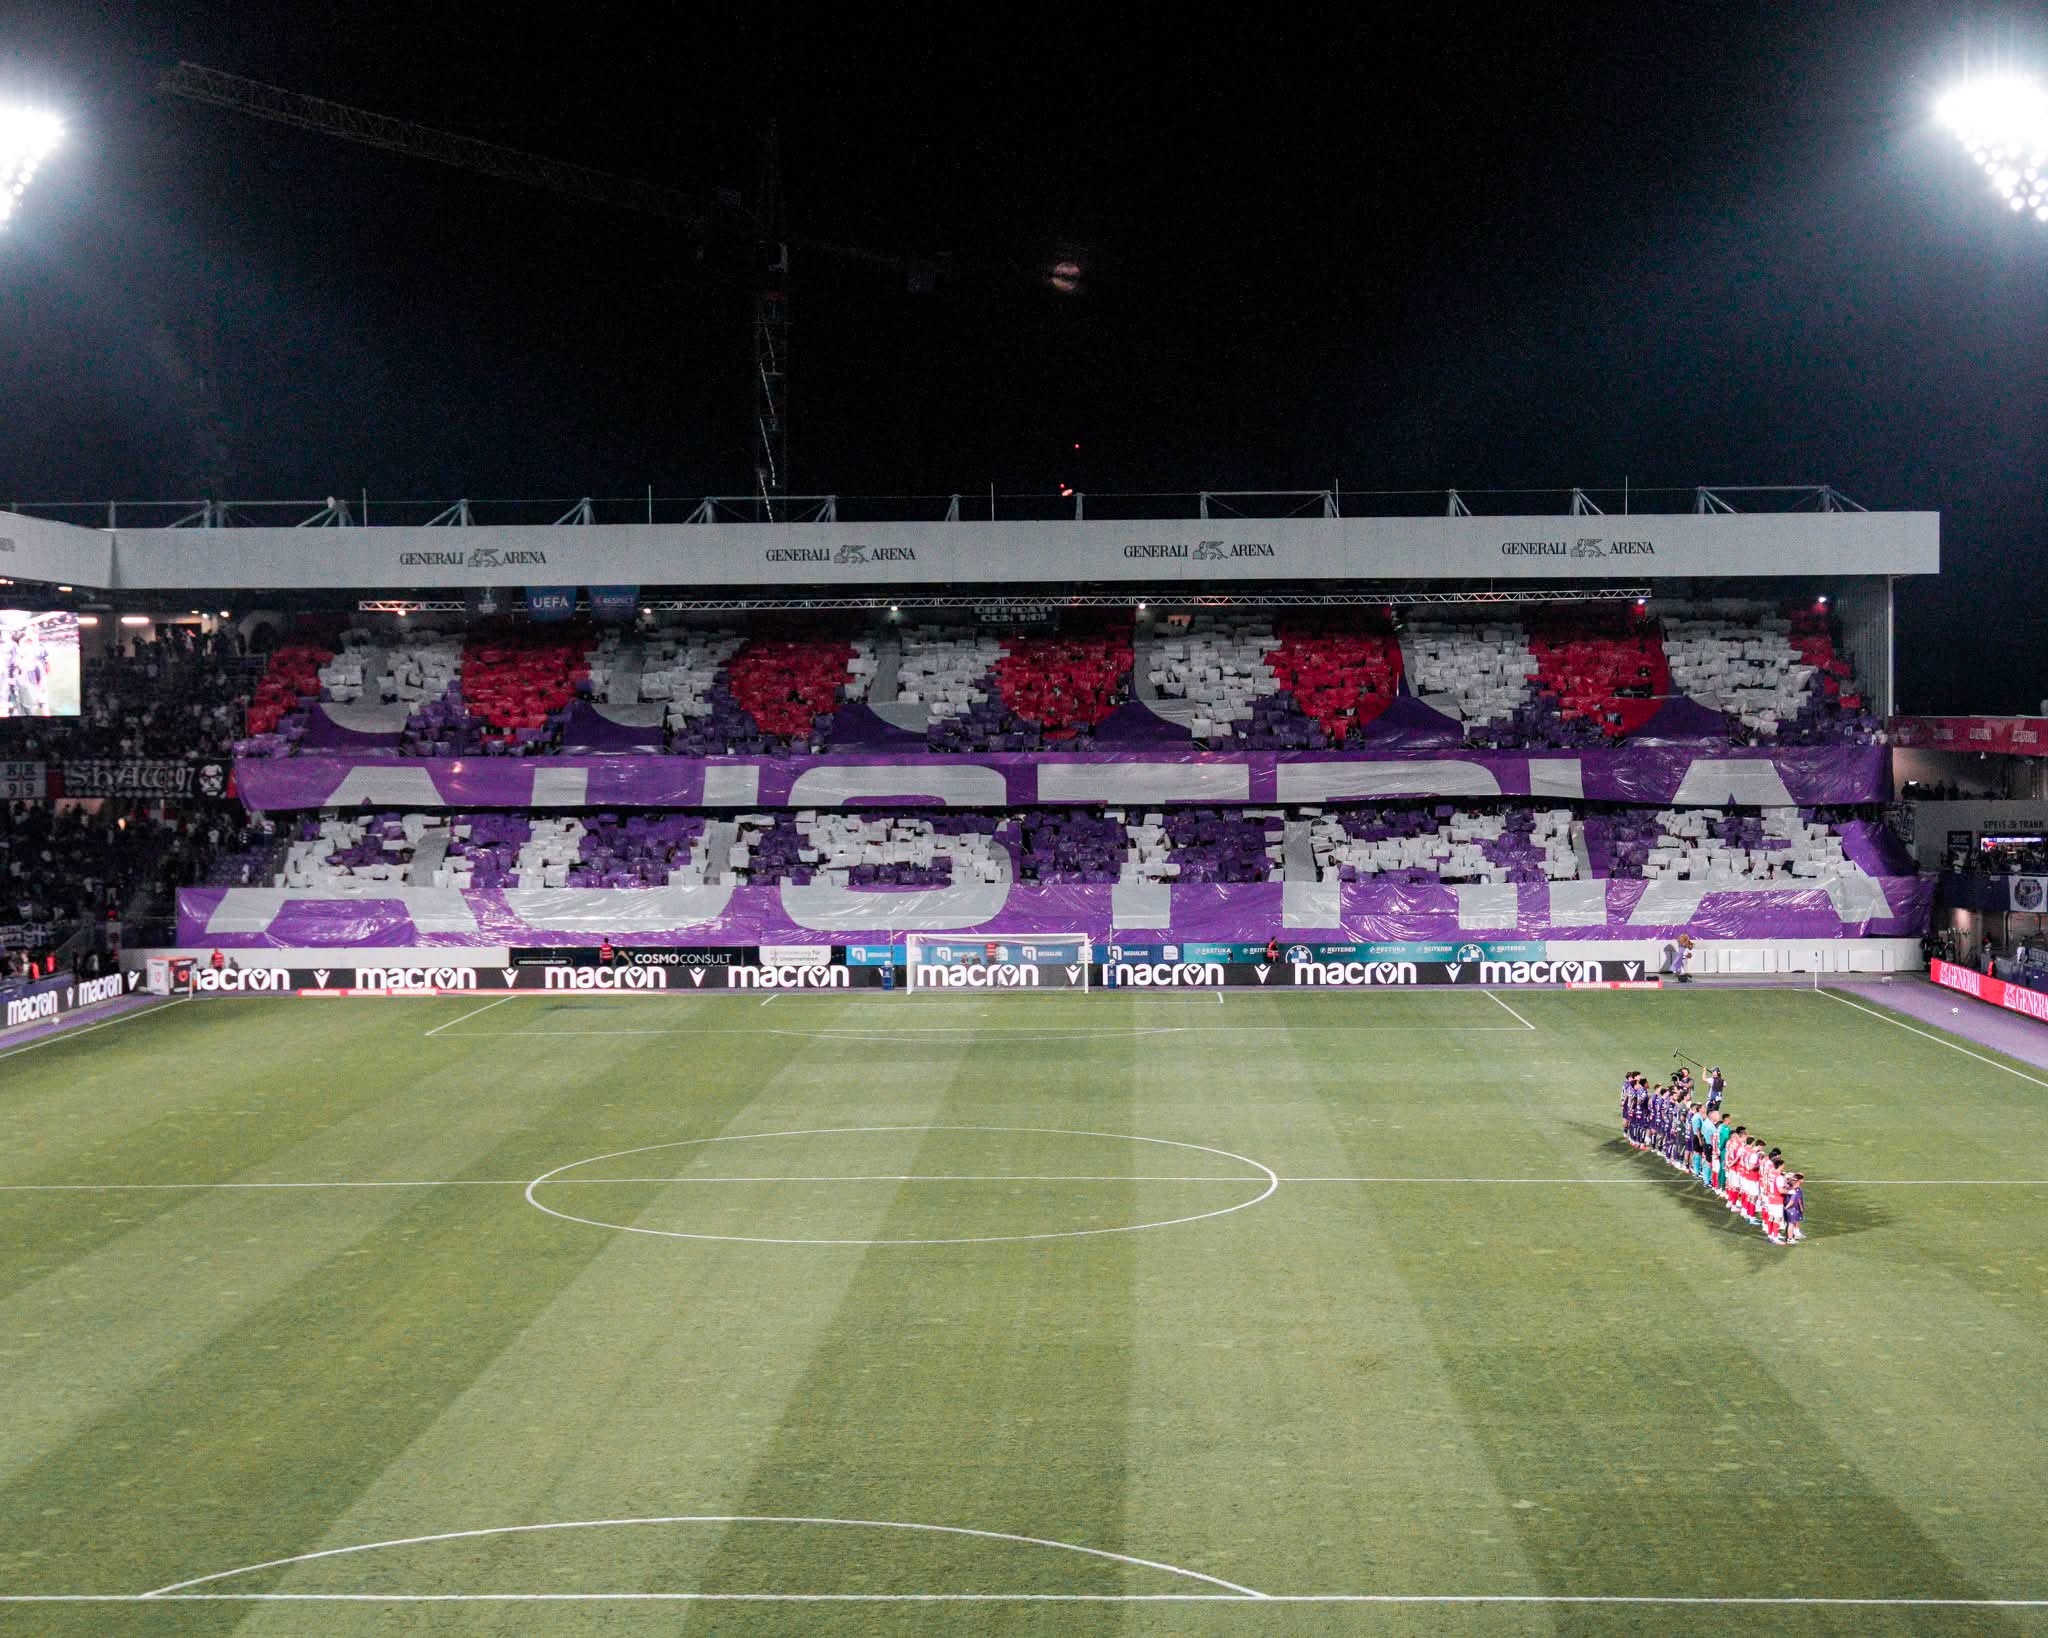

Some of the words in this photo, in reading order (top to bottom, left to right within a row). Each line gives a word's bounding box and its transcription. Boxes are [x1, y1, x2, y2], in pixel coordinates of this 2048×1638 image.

[400, 553, 463, 565] GENERALI
[503, 551, 546, 564] ARENA
[766, 549, 830, 561] GENERALI
[871, 548, 915, 560] ARENA
[1124, 545, 1188, 558] GENERALI
[1230, 544, 1274, 557] ARENA
[1502, 542, 1566, 555] GENERALI
[1610, 541, 1655, 554] ARENA
[533, 597, 569, 608] UEFA
[635, 954, 679, 964] COSMO
[680, 954, 732, 964] CONSULT
[355, 967, 476, 989] macron
[545, 966, 667, 989] macron
[728, 965, 850, 988] macron
[917, 964, 1039, 986] macron
[1294, 962, 1417, 985] macron
[1479, 961, 1602, 984] macron
[1948, 964, 1980, 997] GENERALI
[78, 973, 122, 1006] macron
[7, 990, 58, 1026] macron
